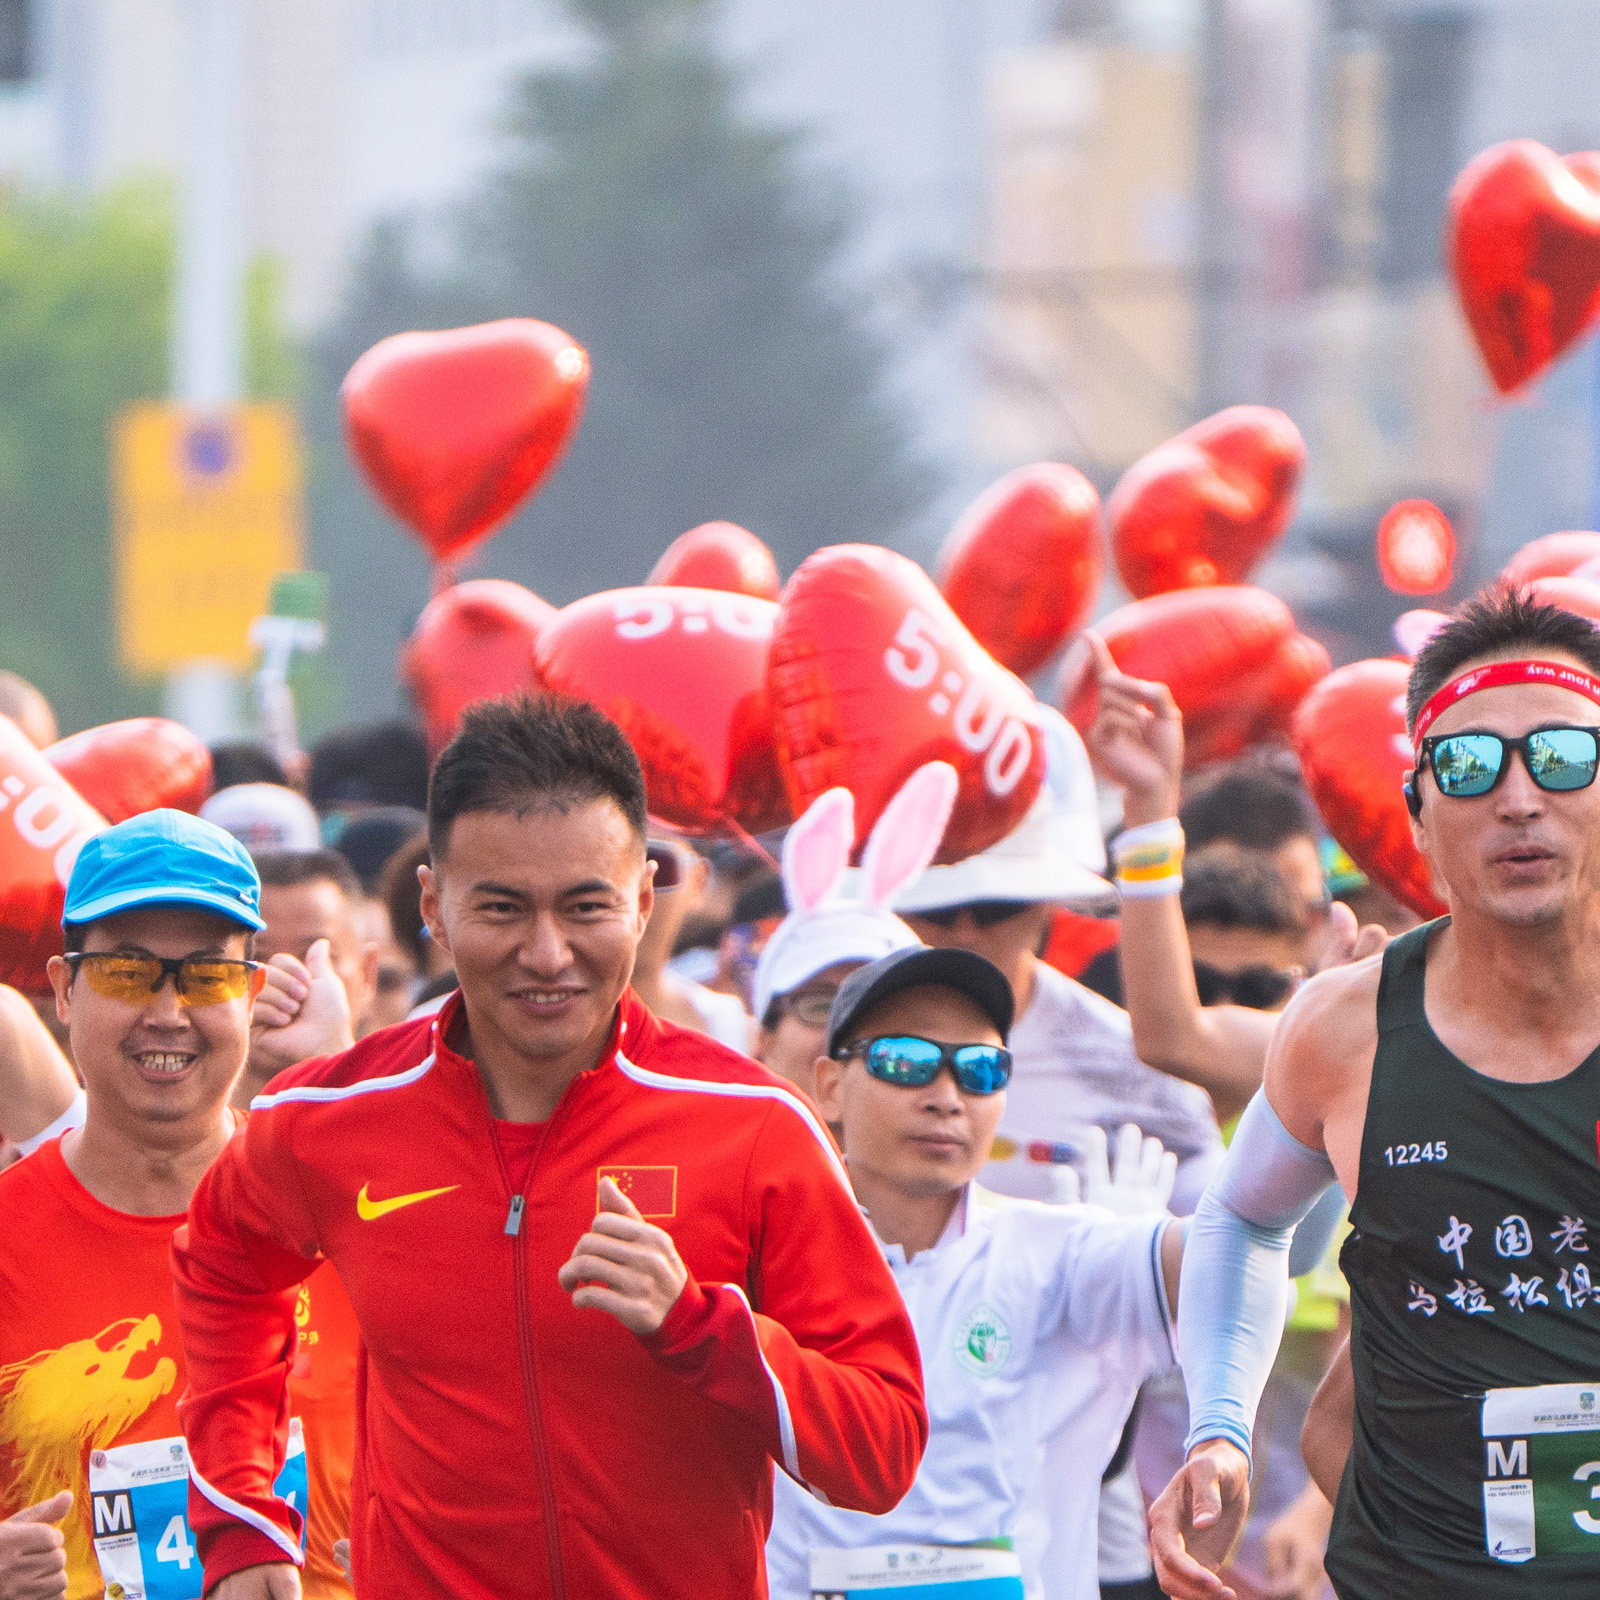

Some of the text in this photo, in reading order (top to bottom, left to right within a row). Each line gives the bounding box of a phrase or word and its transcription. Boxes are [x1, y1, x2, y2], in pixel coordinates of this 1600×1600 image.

[1526, 663, 1555, 677] way
[1559, 671, 1591, 691] your
[884, 610, 1032, 796] 5:00
[1384, 1141, 1448, 1167] 12245
[1487, 1439, 1528, 1477] M
[94, 1493, 134, 1537] M
